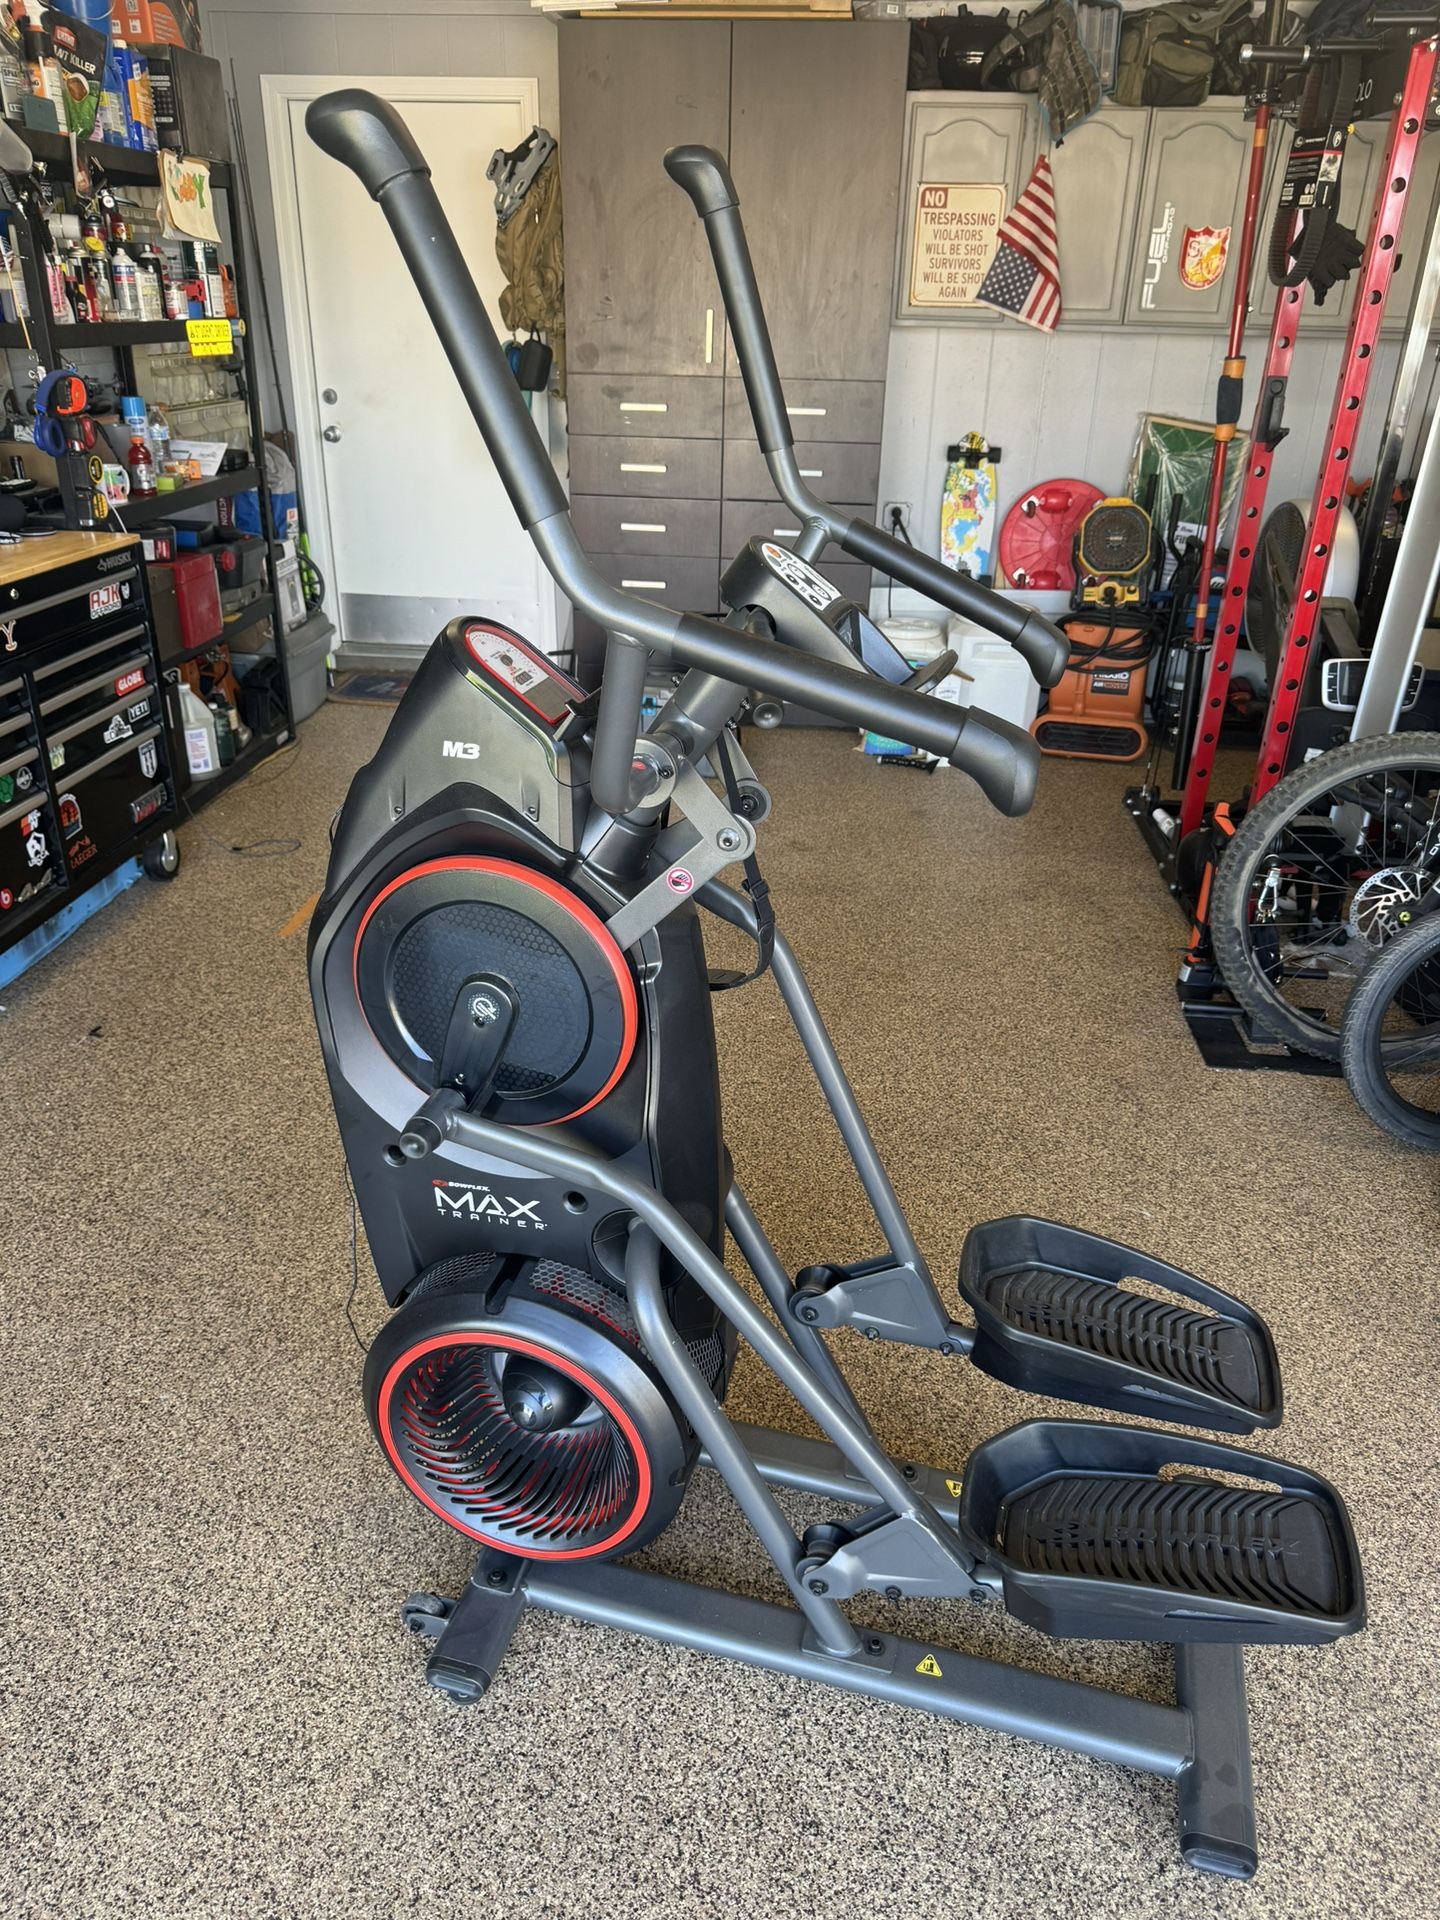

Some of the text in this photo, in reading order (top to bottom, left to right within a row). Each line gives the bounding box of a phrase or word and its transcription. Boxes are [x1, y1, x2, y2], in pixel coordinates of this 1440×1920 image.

[69, 51, 97, 75] KILLER
[924, 190, 946, 207] NO
[923, 211, 996, 226] TRESPASSING
[933, 229, 983, 241] VIOLATORS
[925, 243, 989, 256] WILL BE SHOT
[1141, 207, 1170, 309] FUEL
[929, 257, 982, 270] SURVIVORS
[923, 272, 985, 284] WILL BE SHOT
[939, 287, 967, 298] AGAIN
[90, 583, 120, 610] AJK
[118, 670, 143, 691] GLOBE
[130, 701, 149, 718] YETI
[442, 740, 480, 760] M3
[448, 1181, 491, 1192] BOWFLEX
[434, 1186, 543, 1222] MAX
[437, 1208, 545, 1231] TRAINER
